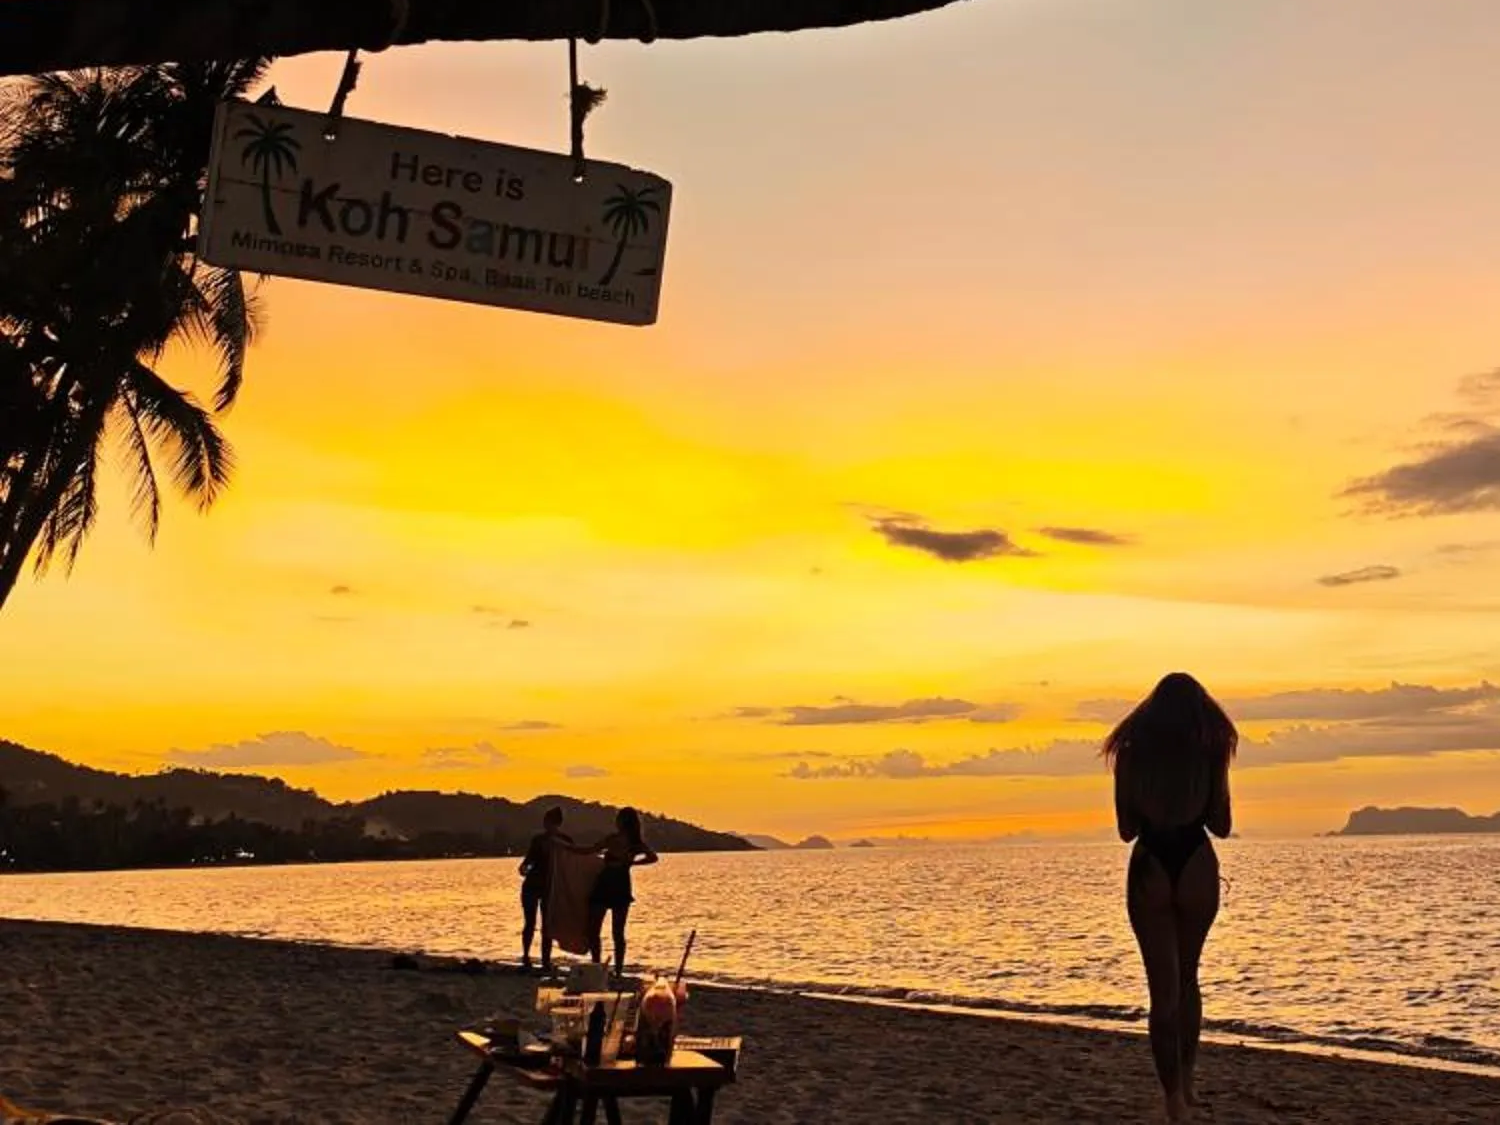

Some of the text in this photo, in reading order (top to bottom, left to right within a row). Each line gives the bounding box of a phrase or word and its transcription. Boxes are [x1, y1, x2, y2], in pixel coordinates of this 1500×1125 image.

[390, 151, 525, 201] Here is
[298, 178, 591, 270] Koh Samui
[231, 230, 321, 260] Mimosa
[328, 244, 402, 272] Resort
[409, 259, 424, 276] &
[578, 281, 636, 308] beach
